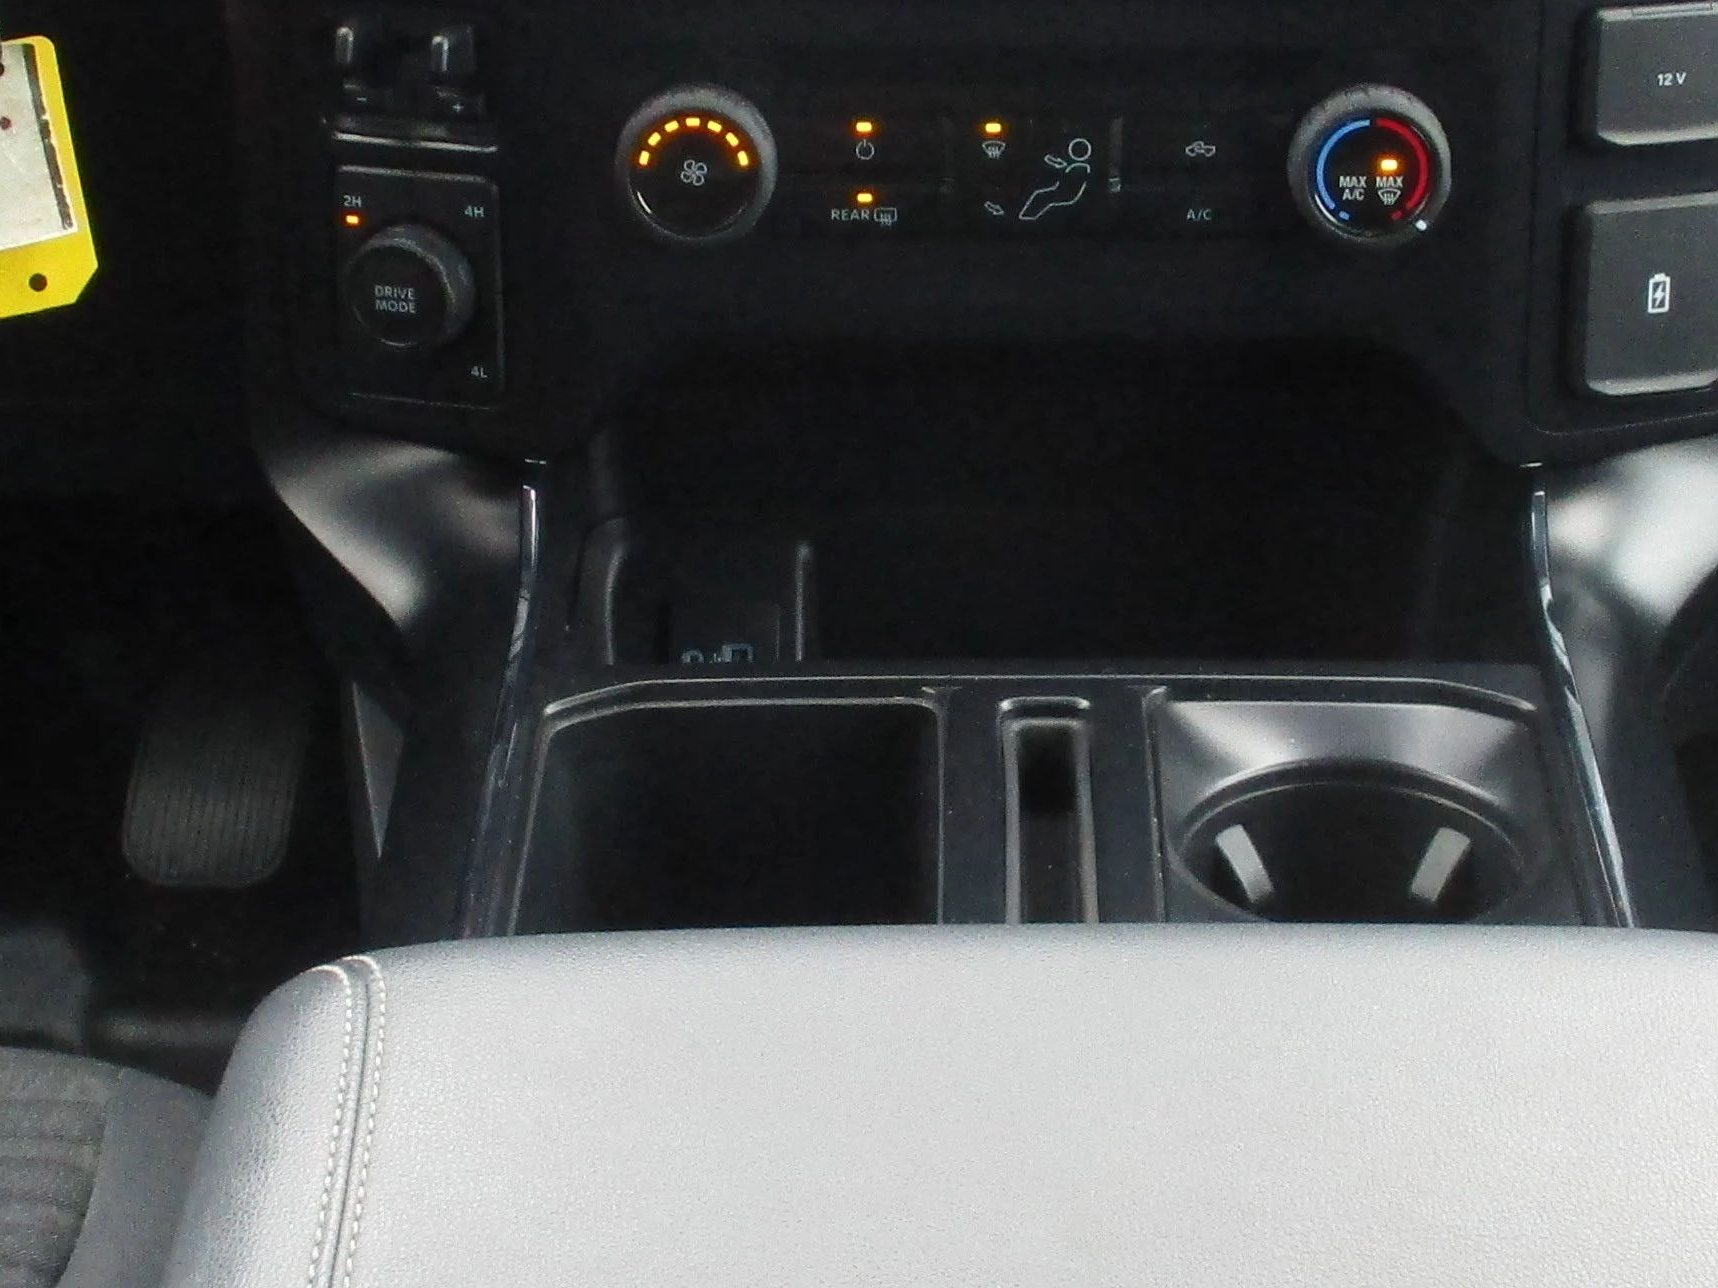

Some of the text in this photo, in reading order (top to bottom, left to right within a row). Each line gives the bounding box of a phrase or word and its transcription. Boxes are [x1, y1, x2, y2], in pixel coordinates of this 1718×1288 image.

[1657, 72, 1687, 86] 12 V
[1338, 175, 1368, 189] MAX
[1375, 175, 1405, 189] MAX
[343, 194, 362, 208] 2H
[1342, 188, 1366, 202] A/C
[464, 205, 485, 218] 4H
[830, 207, 871, 222] REAR
[1186, 208, 1213, 222] A/C
[374, 285, 416, 299] DRIVE
[375, 299, 417, 314] MODE
[470, 366, 488, 379] 4L
